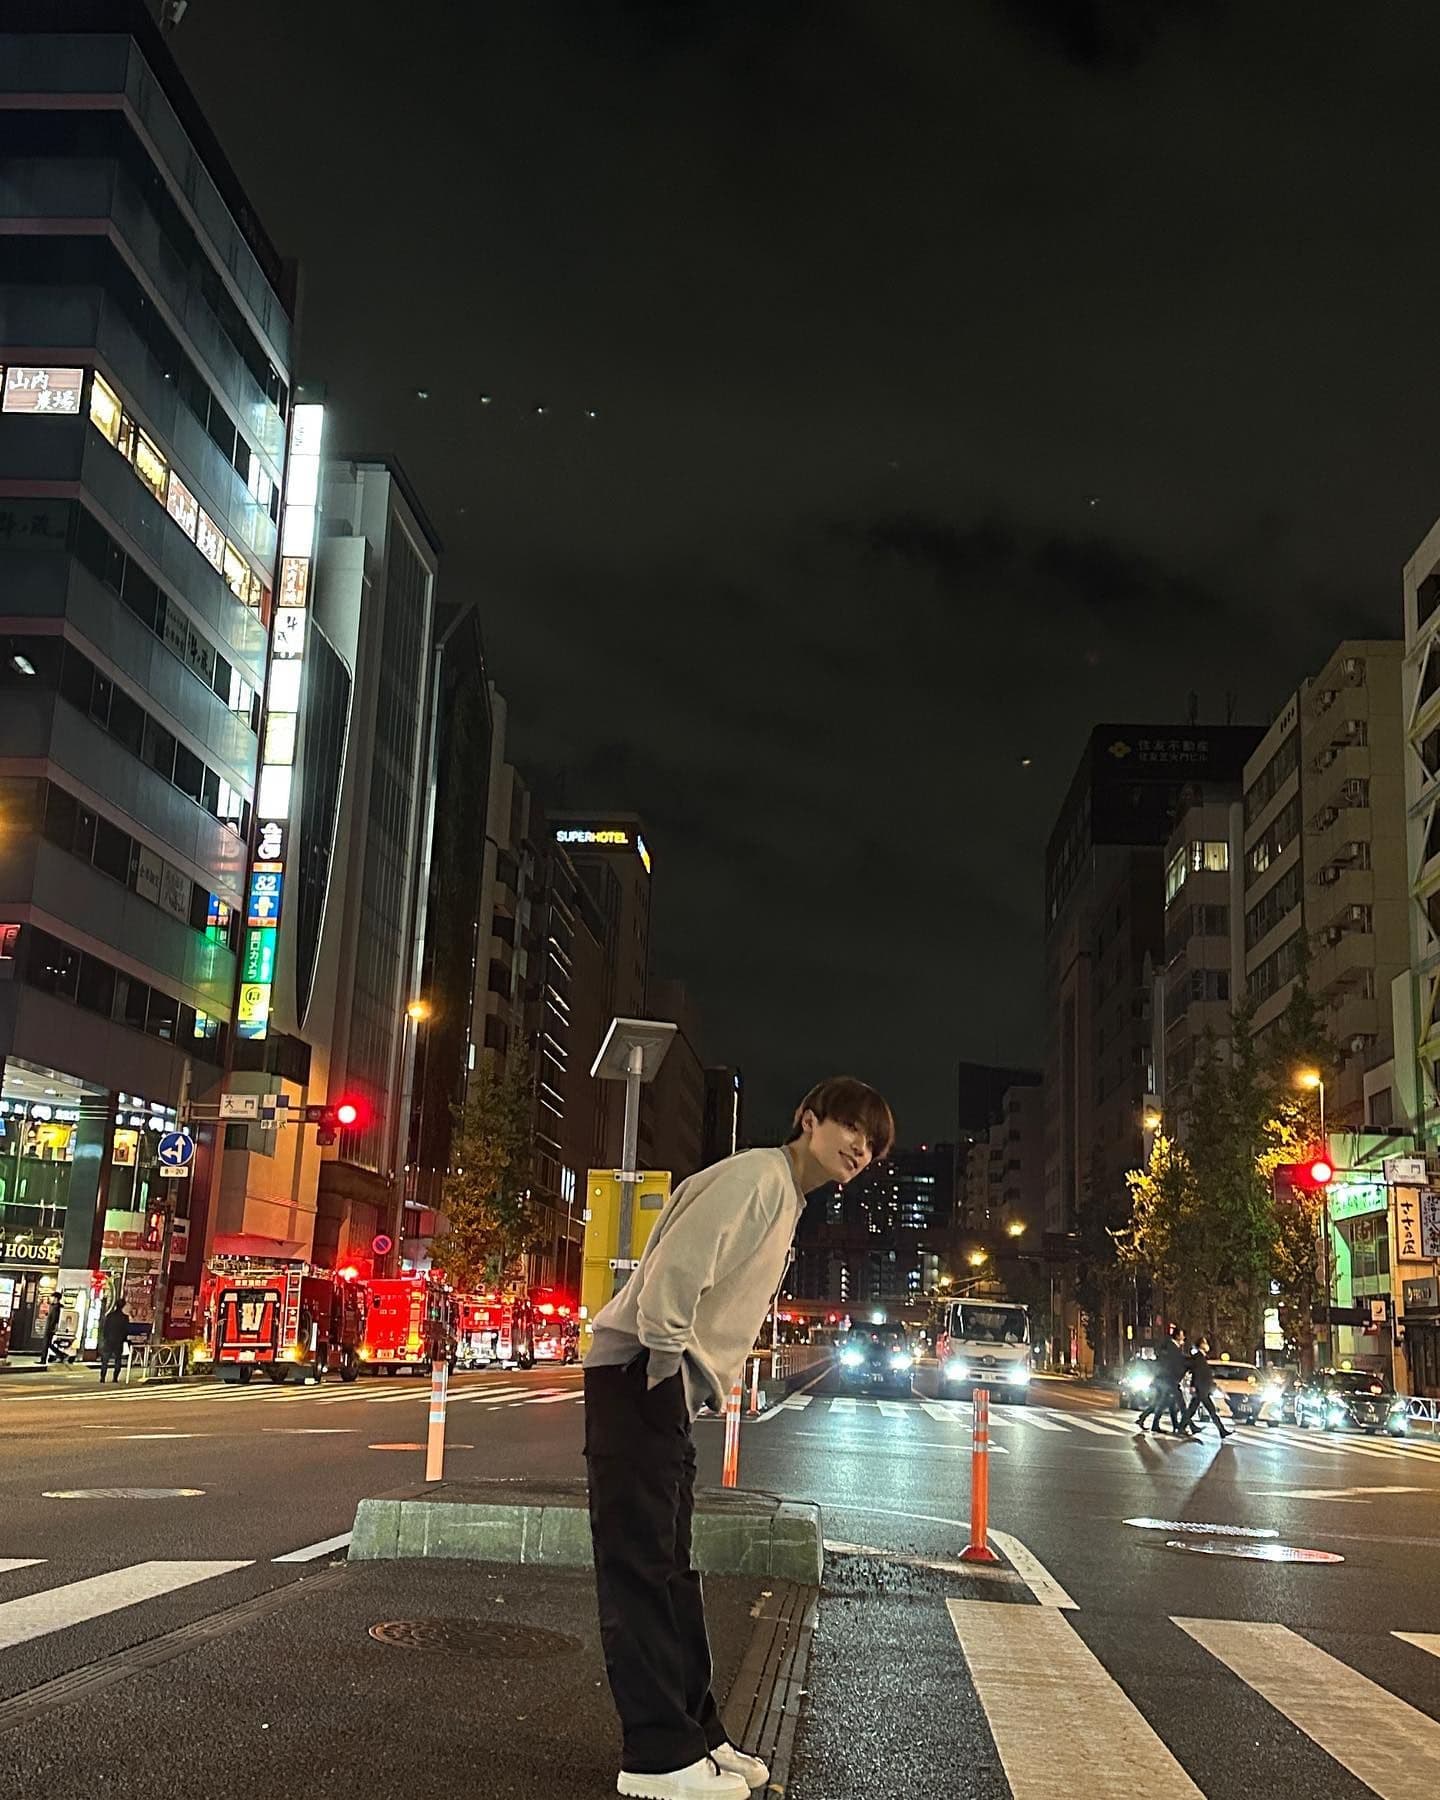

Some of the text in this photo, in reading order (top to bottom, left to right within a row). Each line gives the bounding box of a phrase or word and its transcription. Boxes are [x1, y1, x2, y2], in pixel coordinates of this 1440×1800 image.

[9, 370, 49, 390] 山内
[255, 875, 277, 891] 82
[224, 1098, 255, 1110] 大門
[1389, 1162, 1421, 1175] 大門
[4, 1242, 57, 1260] HOUSE
